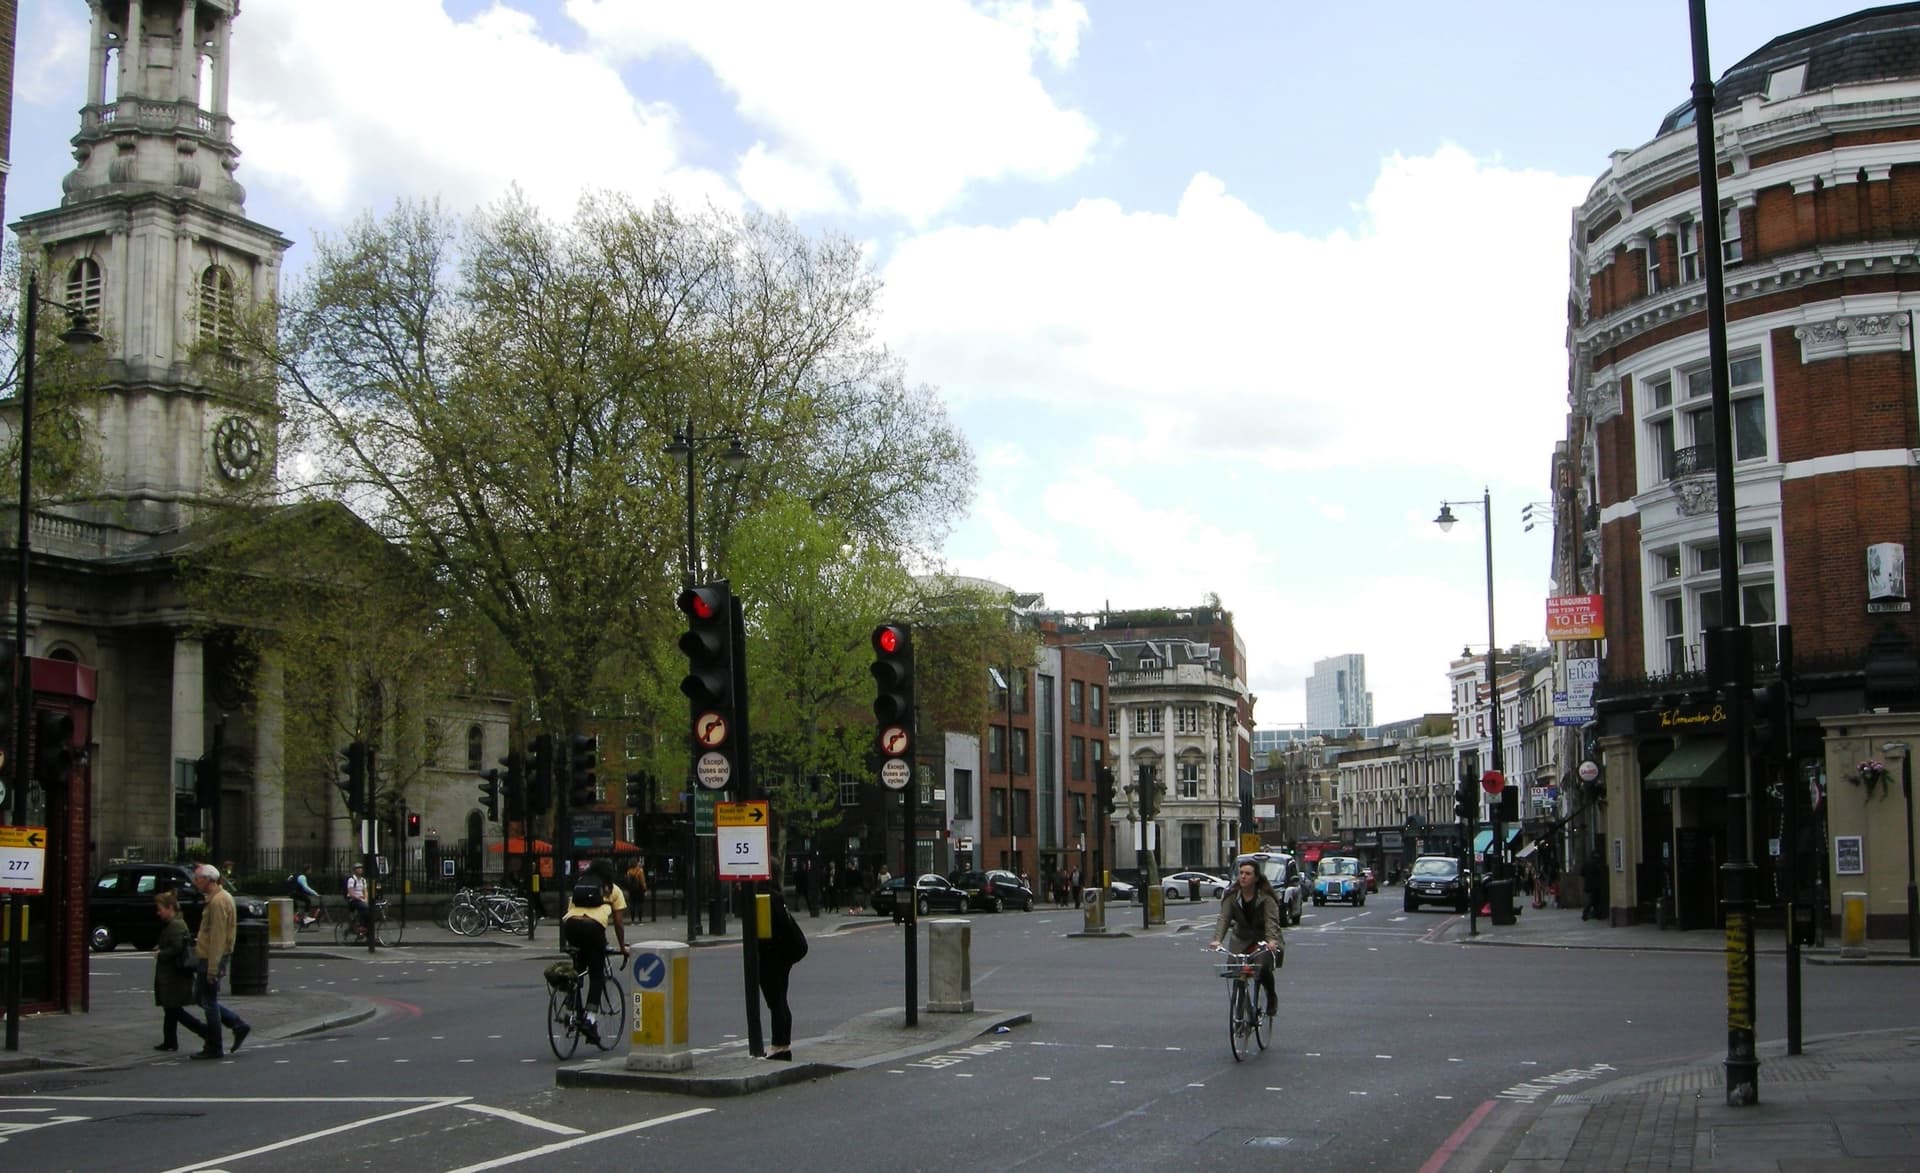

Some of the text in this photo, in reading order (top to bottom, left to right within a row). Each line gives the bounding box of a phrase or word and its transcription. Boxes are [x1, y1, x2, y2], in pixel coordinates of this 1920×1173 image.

[1548, 597, 1591, 607] ALL ENQUIRIES
[1554, 614, 1596, 626] TO LET
[703, 758, 724, 767] Except
[887, 763, 905, 771] Except
[699, 766, 729, 774] buses and
[704, 775, 724, 783] cycles
[735, 842, 750, 854] 55
[9, 860, 30, 871] 277
